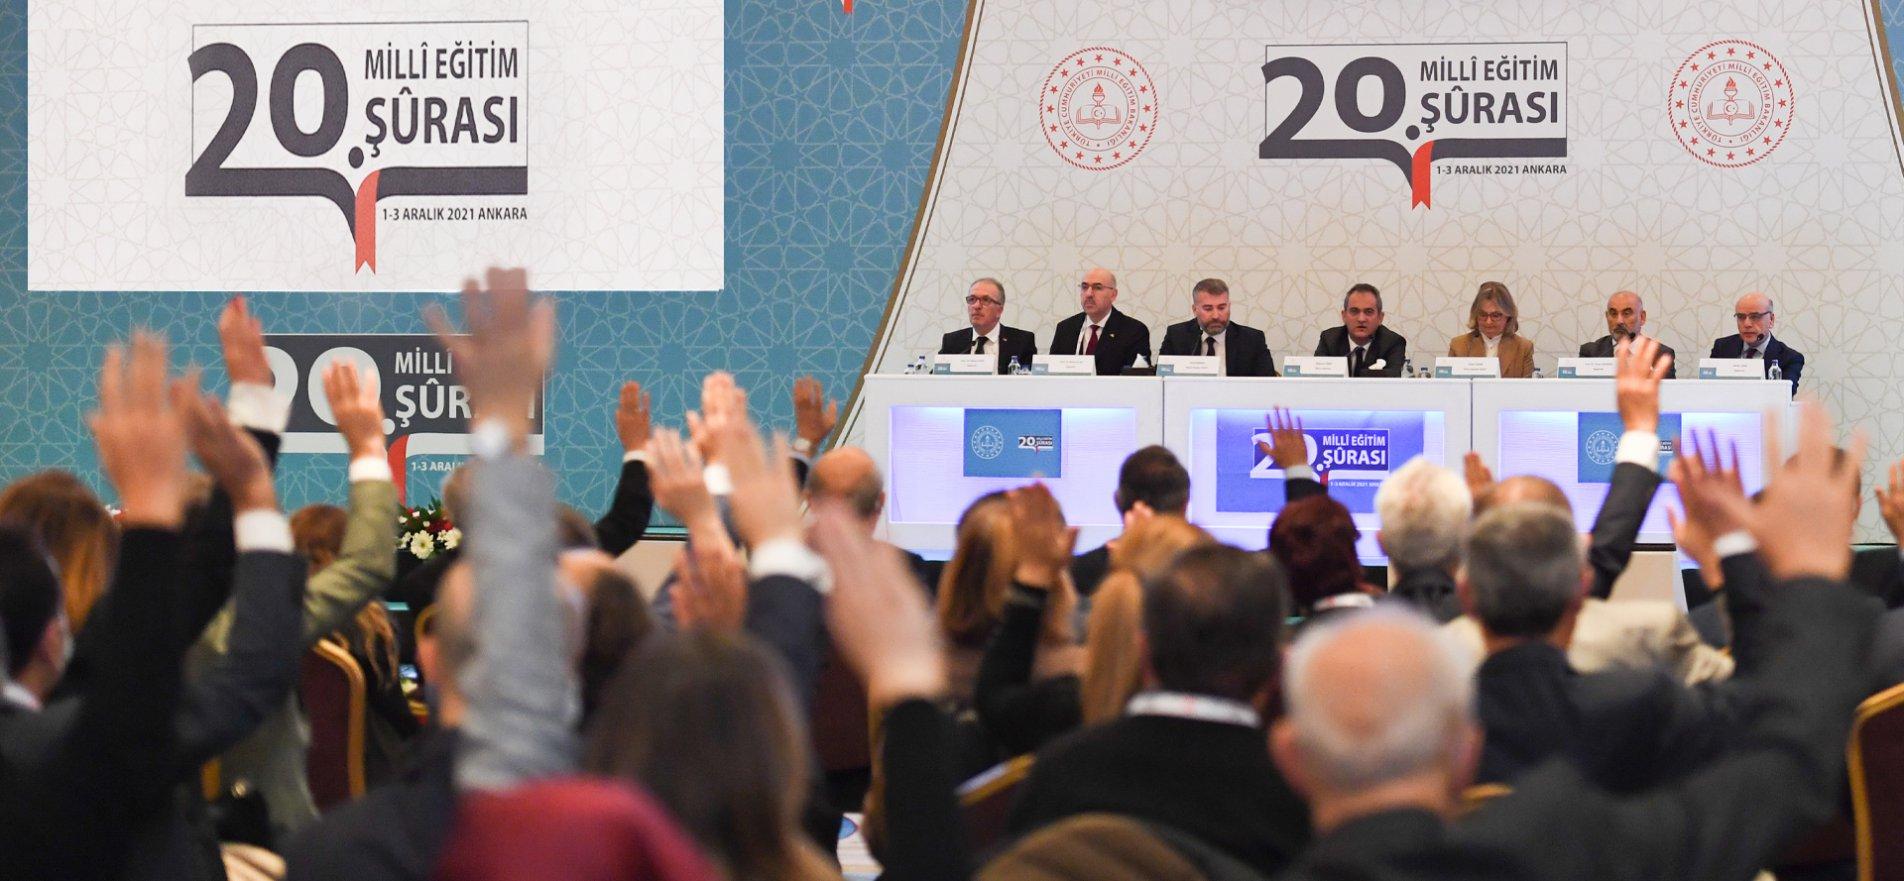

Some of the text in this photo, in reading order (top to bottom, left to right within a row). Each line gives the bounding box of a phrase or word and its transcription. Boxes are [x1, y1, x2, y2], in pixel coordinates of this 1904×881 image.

[365, 40, 519, 80] MİLLÎ EĞİTİM
[1420, 54, 1559, 82] MİLLÎ EĞİTİM
[1420, 85, 1559, 134] ŞÛRASI
[365, 86, 518, 158] ŞÛRASI
[1436, 164, 1567, 175] 1-3 ARALIK 2021 ANKARA
[382, 207, 528, 221] 1-3 ARALIK 2021 ANKARA
[1351, 433, 1386, 447] EĞİTİM
[411, 461, 427, 472] 1-3
[1323, 447, 1386, 468] ŞÛRASI
